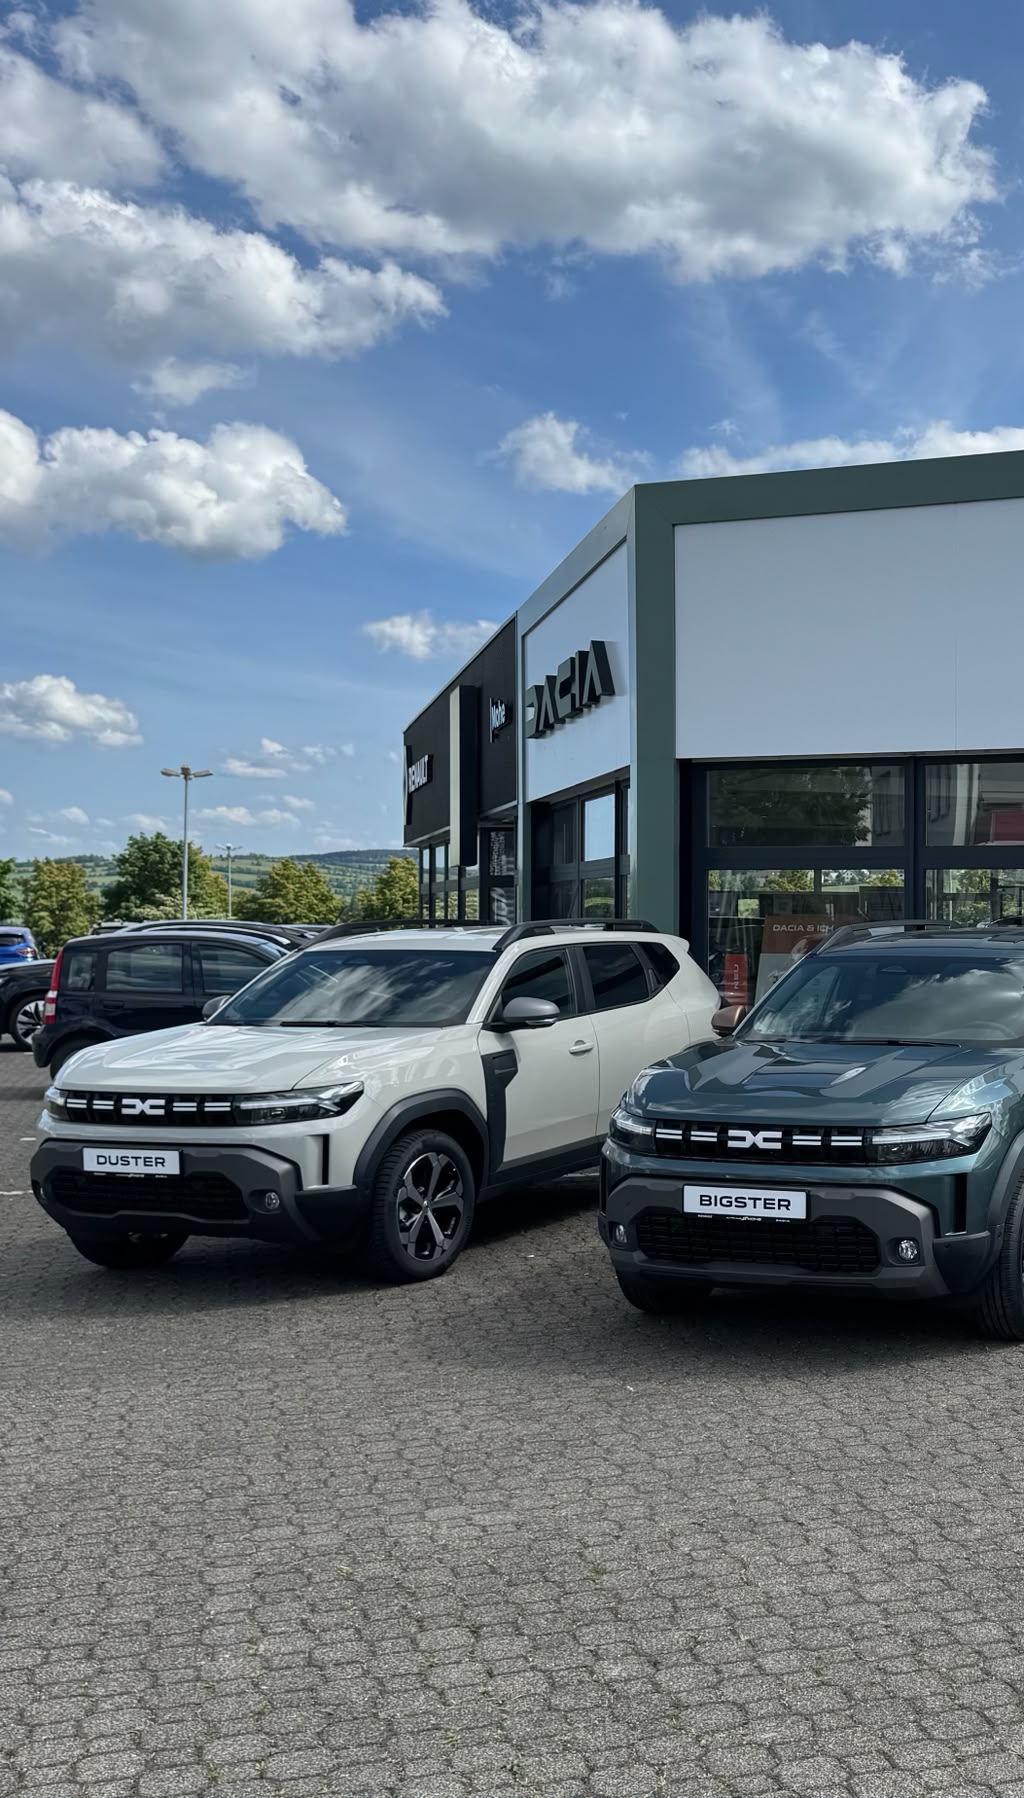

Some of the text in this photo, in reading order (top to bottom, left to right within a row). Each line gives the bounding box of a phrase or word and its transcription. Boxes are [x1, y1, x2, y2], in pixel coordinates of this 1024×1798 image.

[525, 640, 615, 739] DACIA
[408, 754, 429, 793] RENAULT
[772, 924, 804, 932] DACIA
[806, 924, 815, 932] &
[96, 1154, 166, 1168] DUSTER
[699, 1194, 792, 1211] BIGSTER
